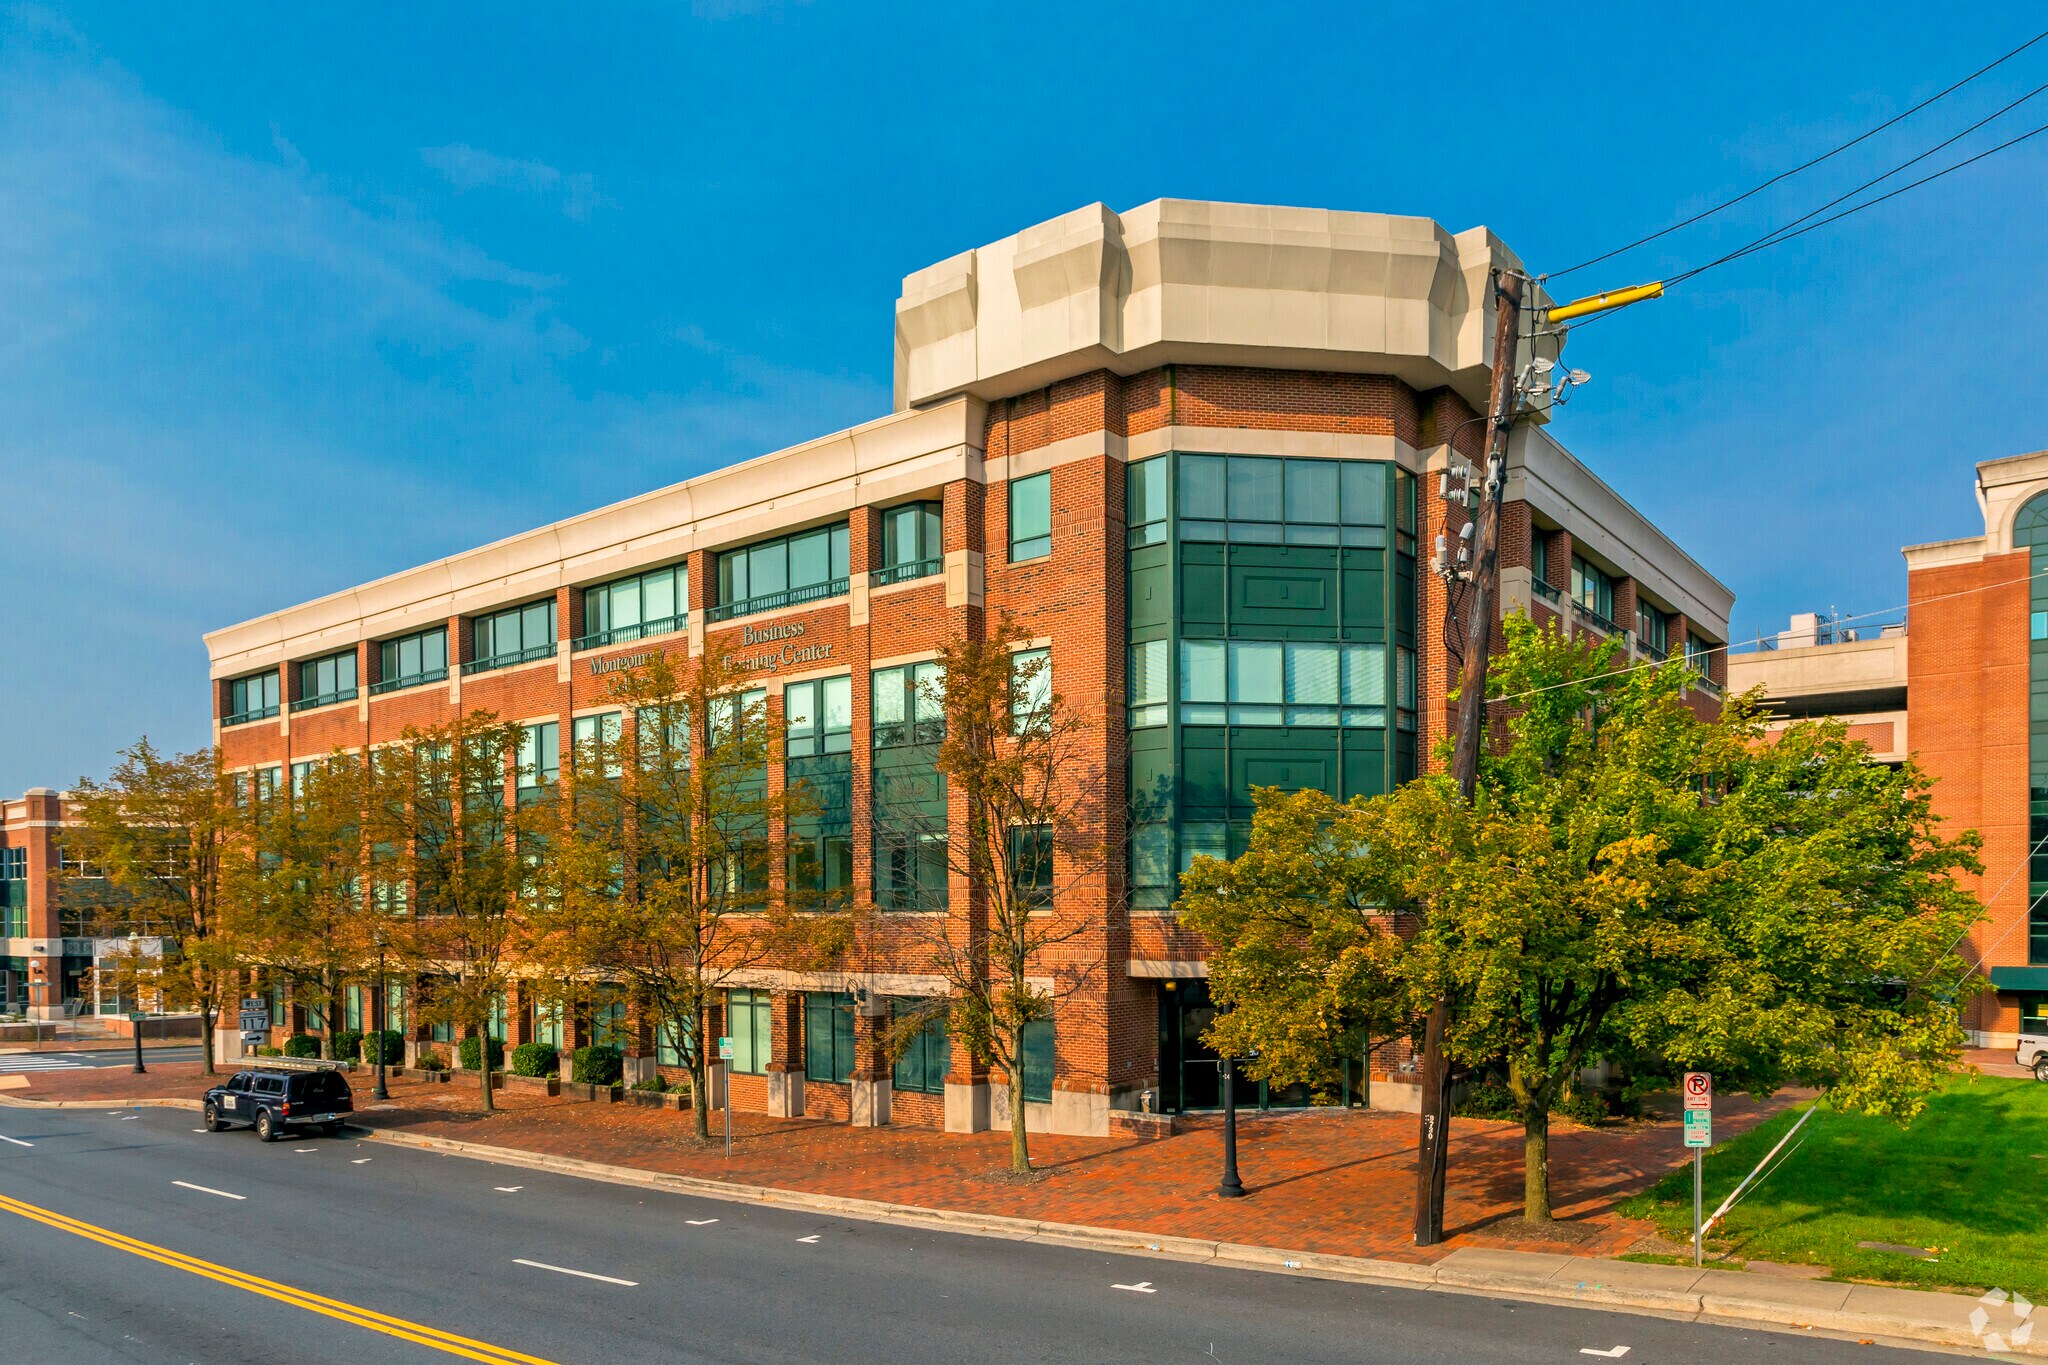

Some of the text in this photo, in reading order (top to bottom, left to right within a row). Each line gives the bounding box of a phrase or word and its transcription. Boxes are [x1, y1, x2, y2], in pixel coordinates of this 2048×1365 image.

[743, 621, 805, 646] Business
[590, 649, 666, 676] Montgomy
[781, 643, 832, 666] Center
[245, 1000, 262, 1008] WEST
[242, 1017, 266, 1030] 117
